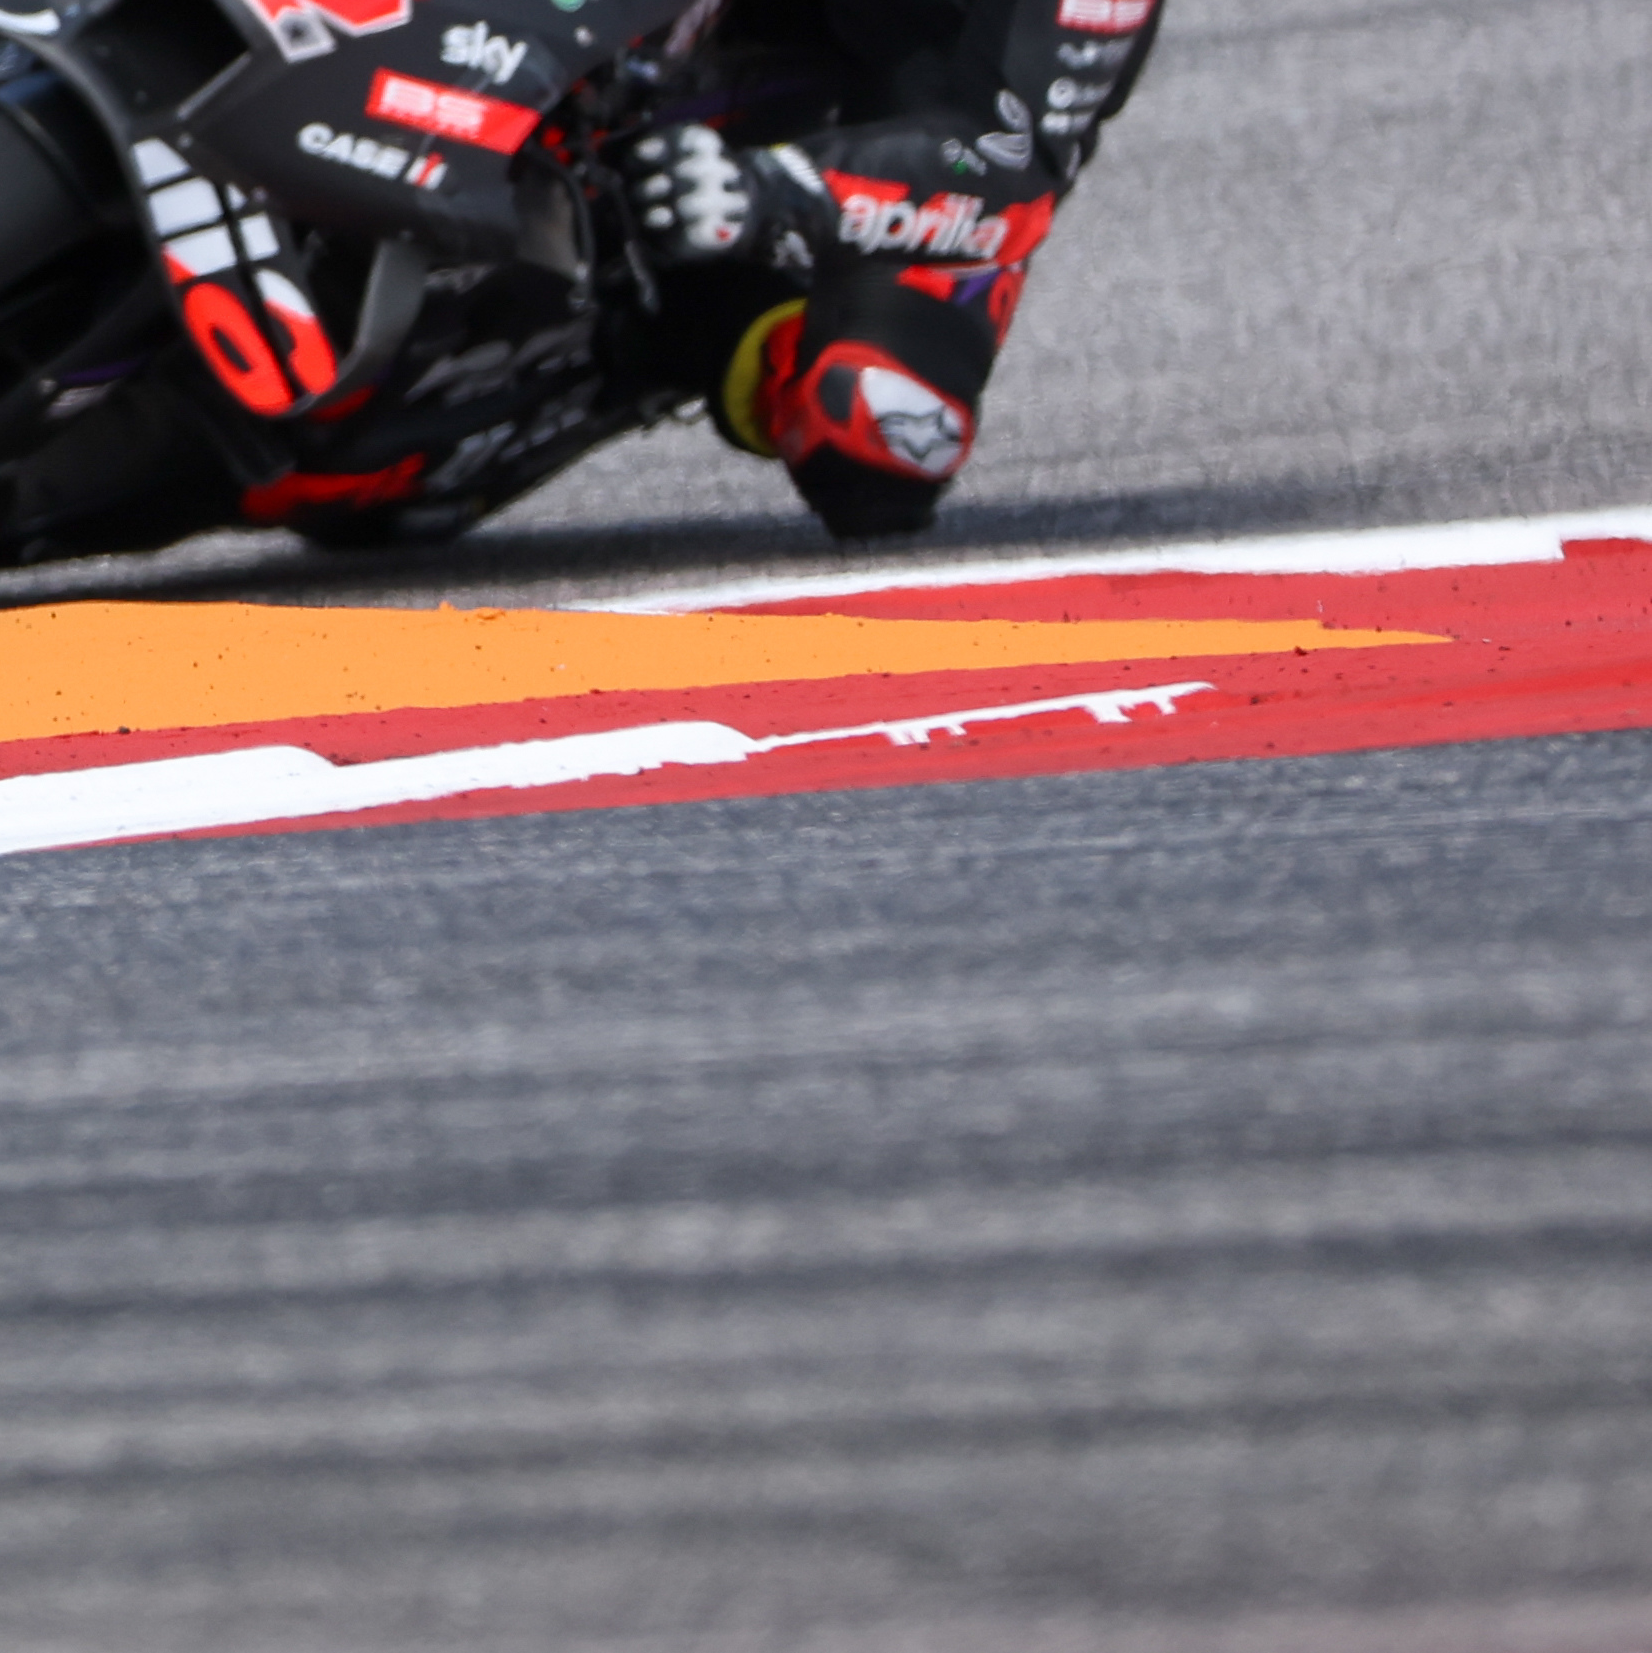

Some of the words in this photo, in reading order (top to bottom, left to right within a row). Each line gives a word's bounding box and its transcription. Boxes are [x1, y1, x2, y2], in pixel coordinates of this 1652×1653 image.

[440, 20, 528, 85] sky
[296, 121, 411, 180] CASE
[838, 192, 1010, 260] aprilia
